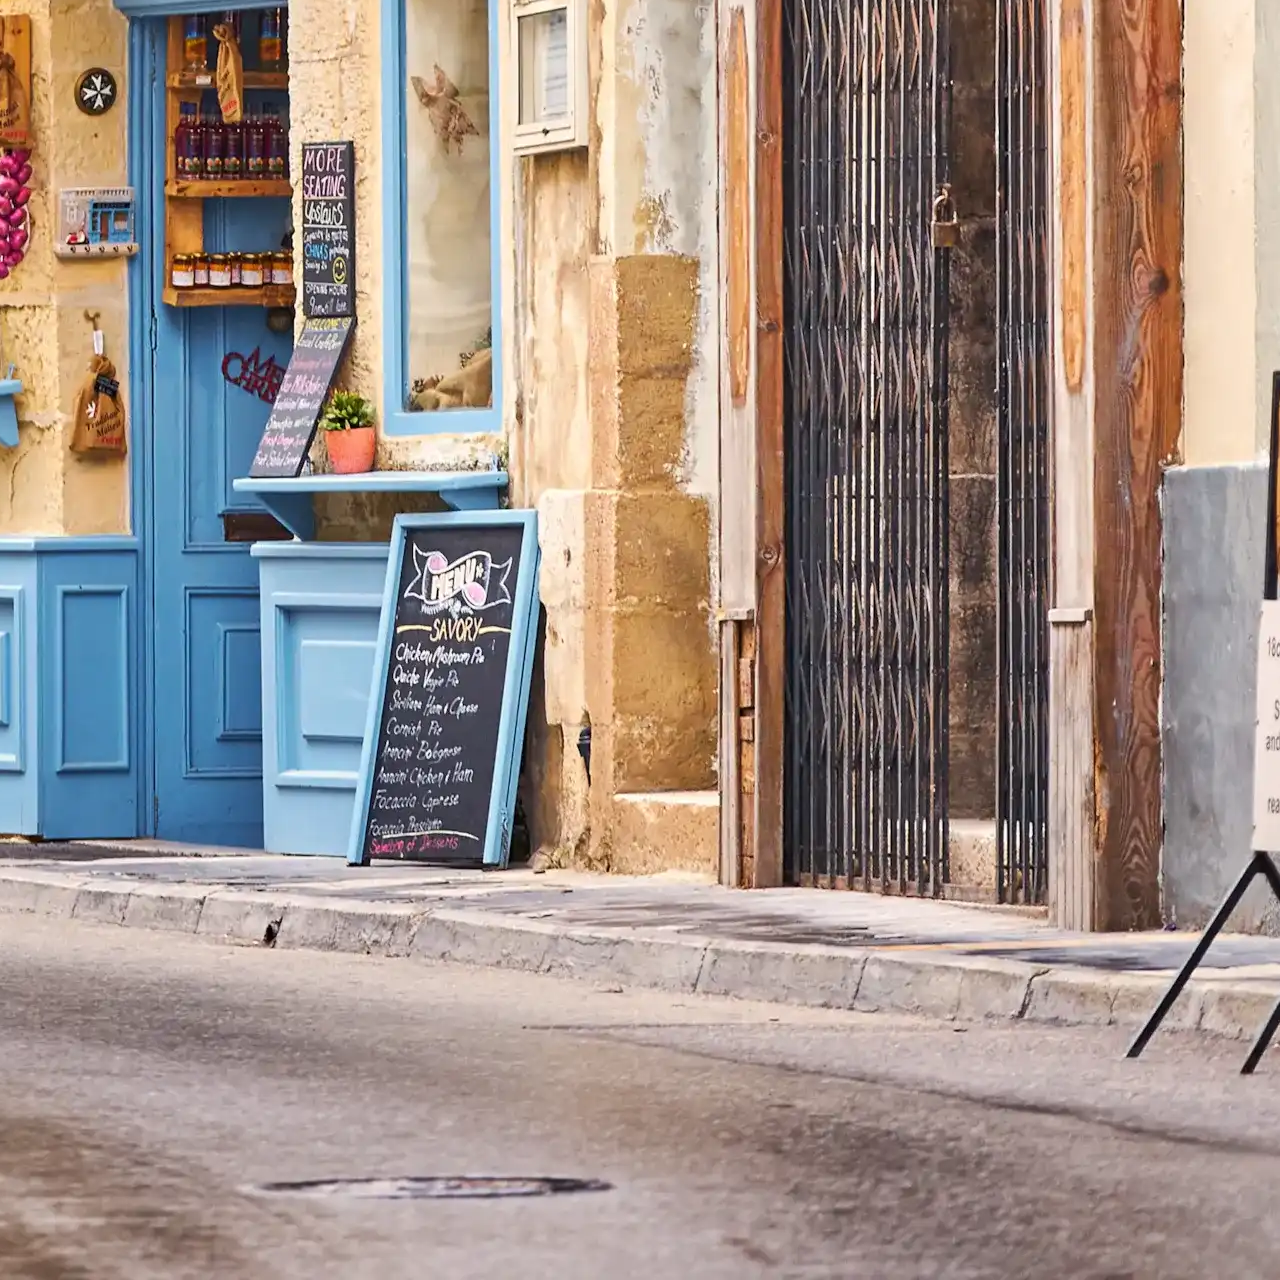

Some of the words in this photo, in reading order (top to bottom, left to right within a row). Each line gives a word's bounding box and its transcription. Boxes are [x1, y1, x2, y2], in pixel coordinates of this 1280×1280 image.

[304, 147, 346, 173] MORE
[304, 174, 347, 198] SEATING
[431, 558, 476, 600] MENU
[430, 617, 483, 642] SAVORY
[395, 642, 429, 665] Chicken
[471, 646, 485, 664] Pie
[393, 665, 420, 685] Quiche
[423, 669, 445, 692] Veggie
[446, 670, 459, 687] Pie
[423, 695, 443, 716] Ham
[450, 697, 479, 719] Cheese
[386, 717, 422, 740] Cornish
[428, 720, 443, 736] Pie
[1266, 730, 1280, 751] and
[417, 740, 462, 764] Bolognese
[410, 767, 443, 787] Chicken
[452, 761, 474, 783] Ham
[373, 789, 417, 810] Focaccia
[369, 819, 405, 836] Focaccia
[370, 838, 404, 854] Selection
[406, 836, 416, 851] of
[420, 834, 459, 851] Desserts
